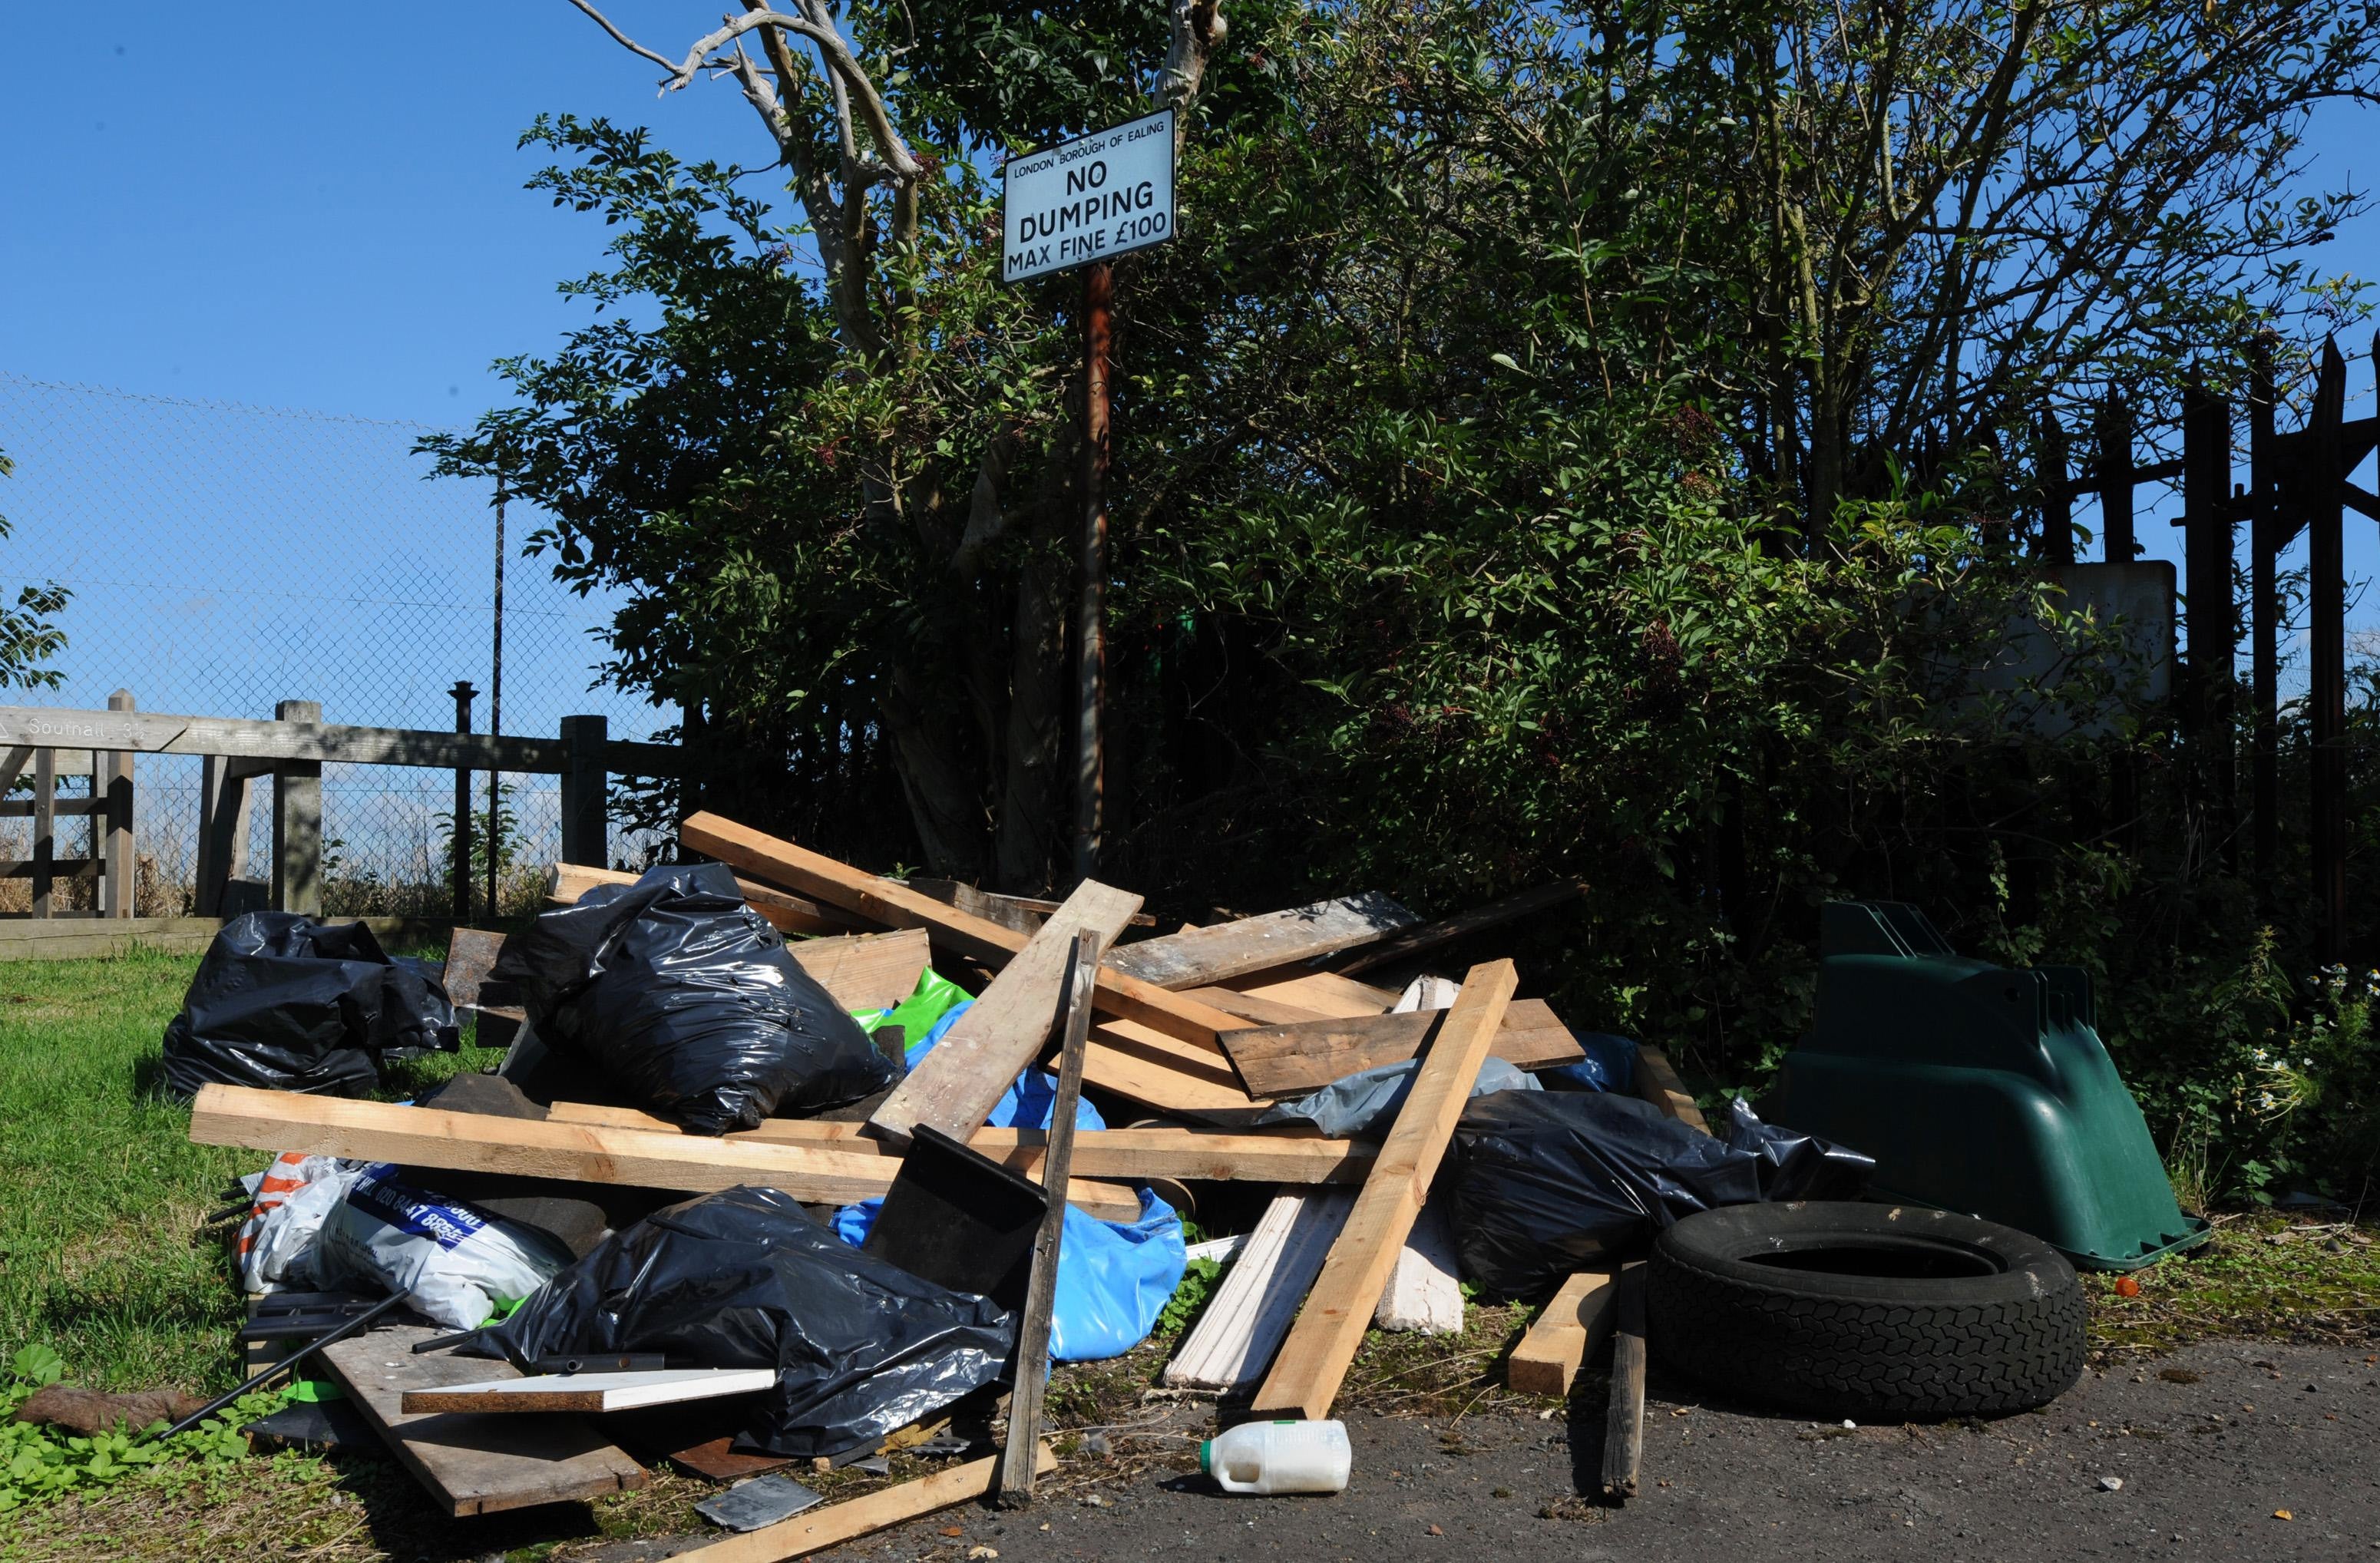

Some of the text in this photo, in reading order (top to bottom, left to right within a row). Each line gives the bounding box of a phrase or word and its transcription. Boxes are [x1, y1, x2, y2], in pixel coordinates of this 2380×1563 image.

[1014, 121, 1164, 179] LONDON BOROUGH OF EALING
[1066, 160, 1107, 196] NO
[1020, 181, 1153, 243] DUMPING
[1008, 211, 1166, 274] MAX FINE £100
[28, 719, 105, 737] Southall
[375, 1186, 397, 1207] 020
[393, 1195, 429, 1221] 8447
